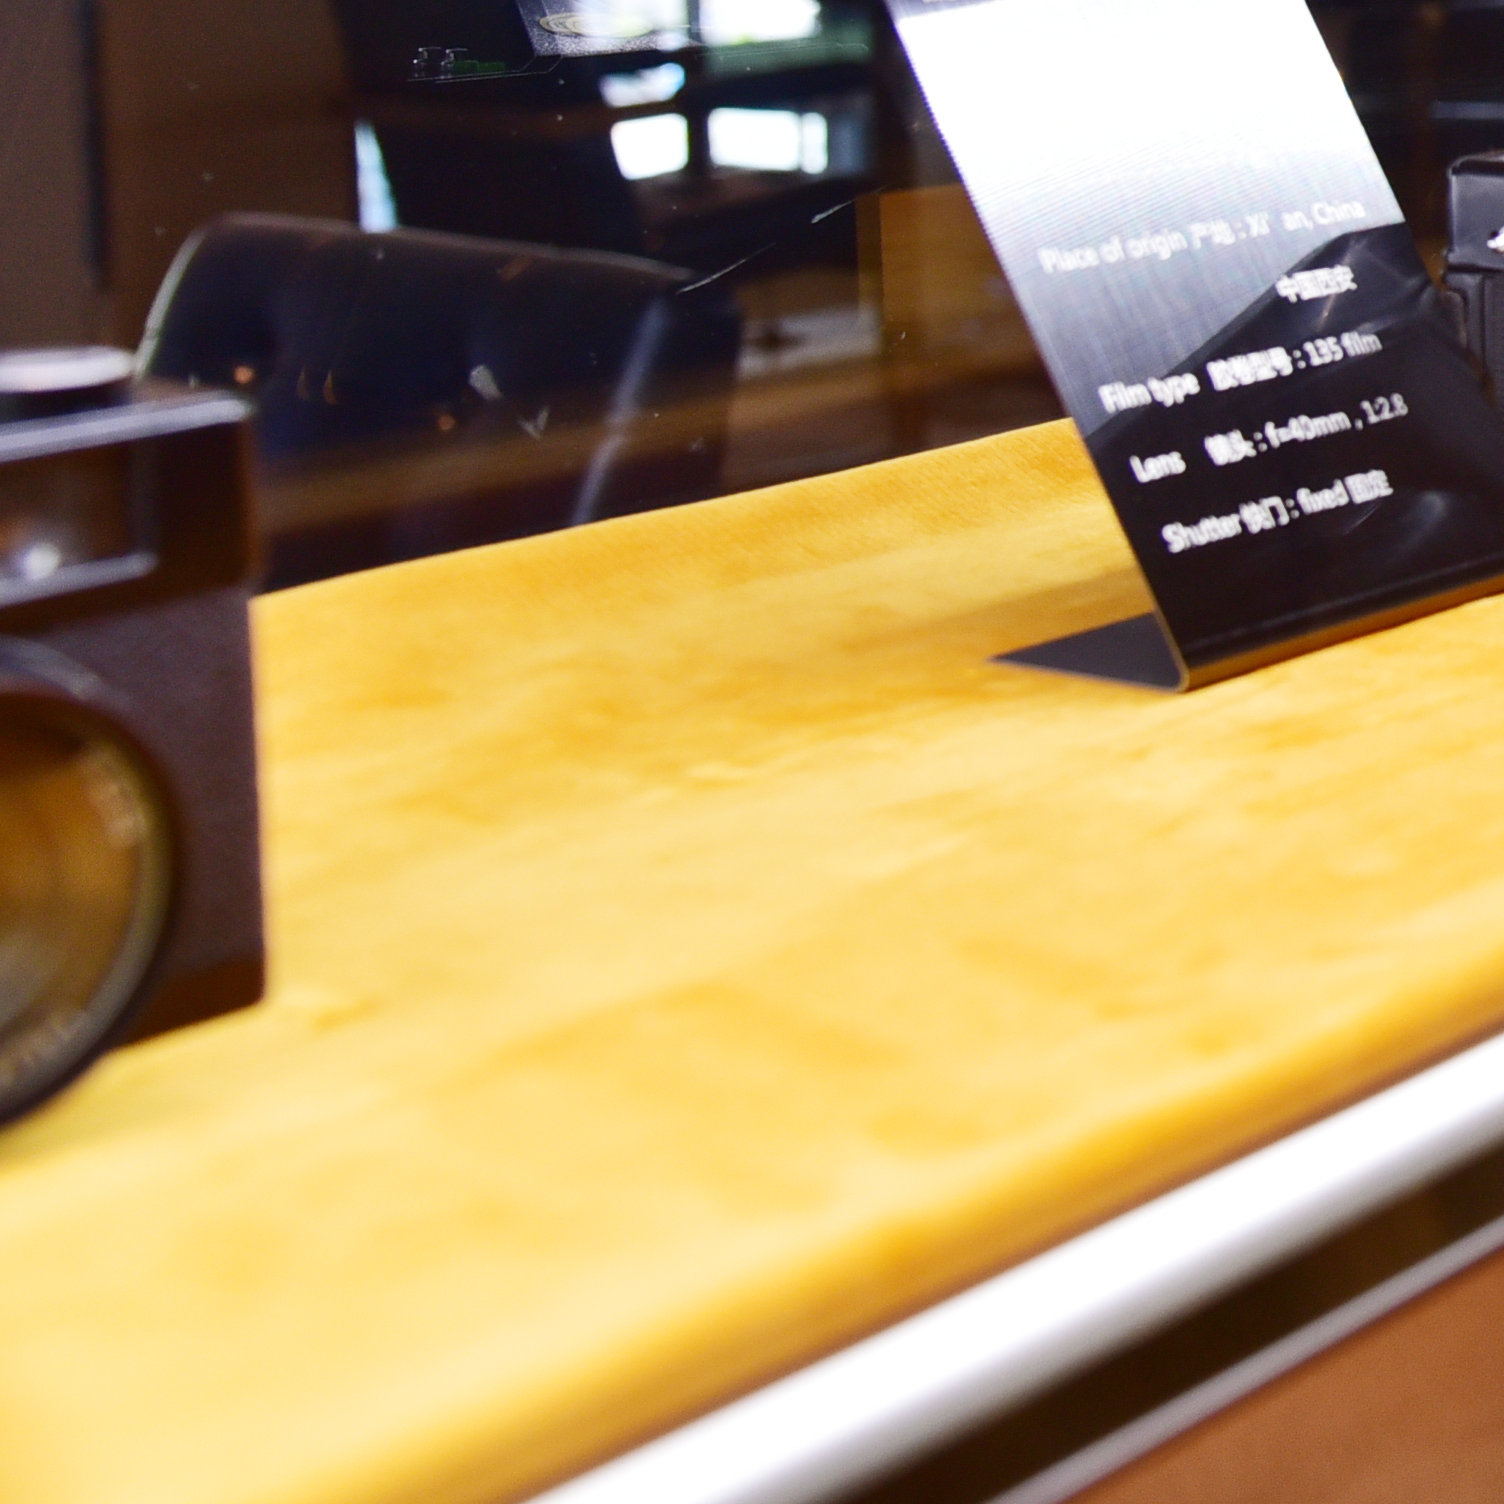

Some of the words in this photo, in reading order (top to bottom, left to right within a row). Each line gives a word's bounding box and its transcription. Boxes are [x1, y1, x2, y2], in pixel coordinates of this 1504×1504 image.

[1038, 246, 1100, 274] Place
[1099, 236, 1126, 264] of
[1125, 229, 1188, 261] origin
[1311, 200, 1367, 226] China
[1097, 380, 1152, 414] Film
[1147, 373, 1201, 407] type
[1302, 335, 1344, 367] 135
[1340, 331, 1383, 358] film
[1129, 451, 1187, 484] Lens
[1161, 512, 1243, 554] Shutter
[1296, 478, 1350, 515] fixed
